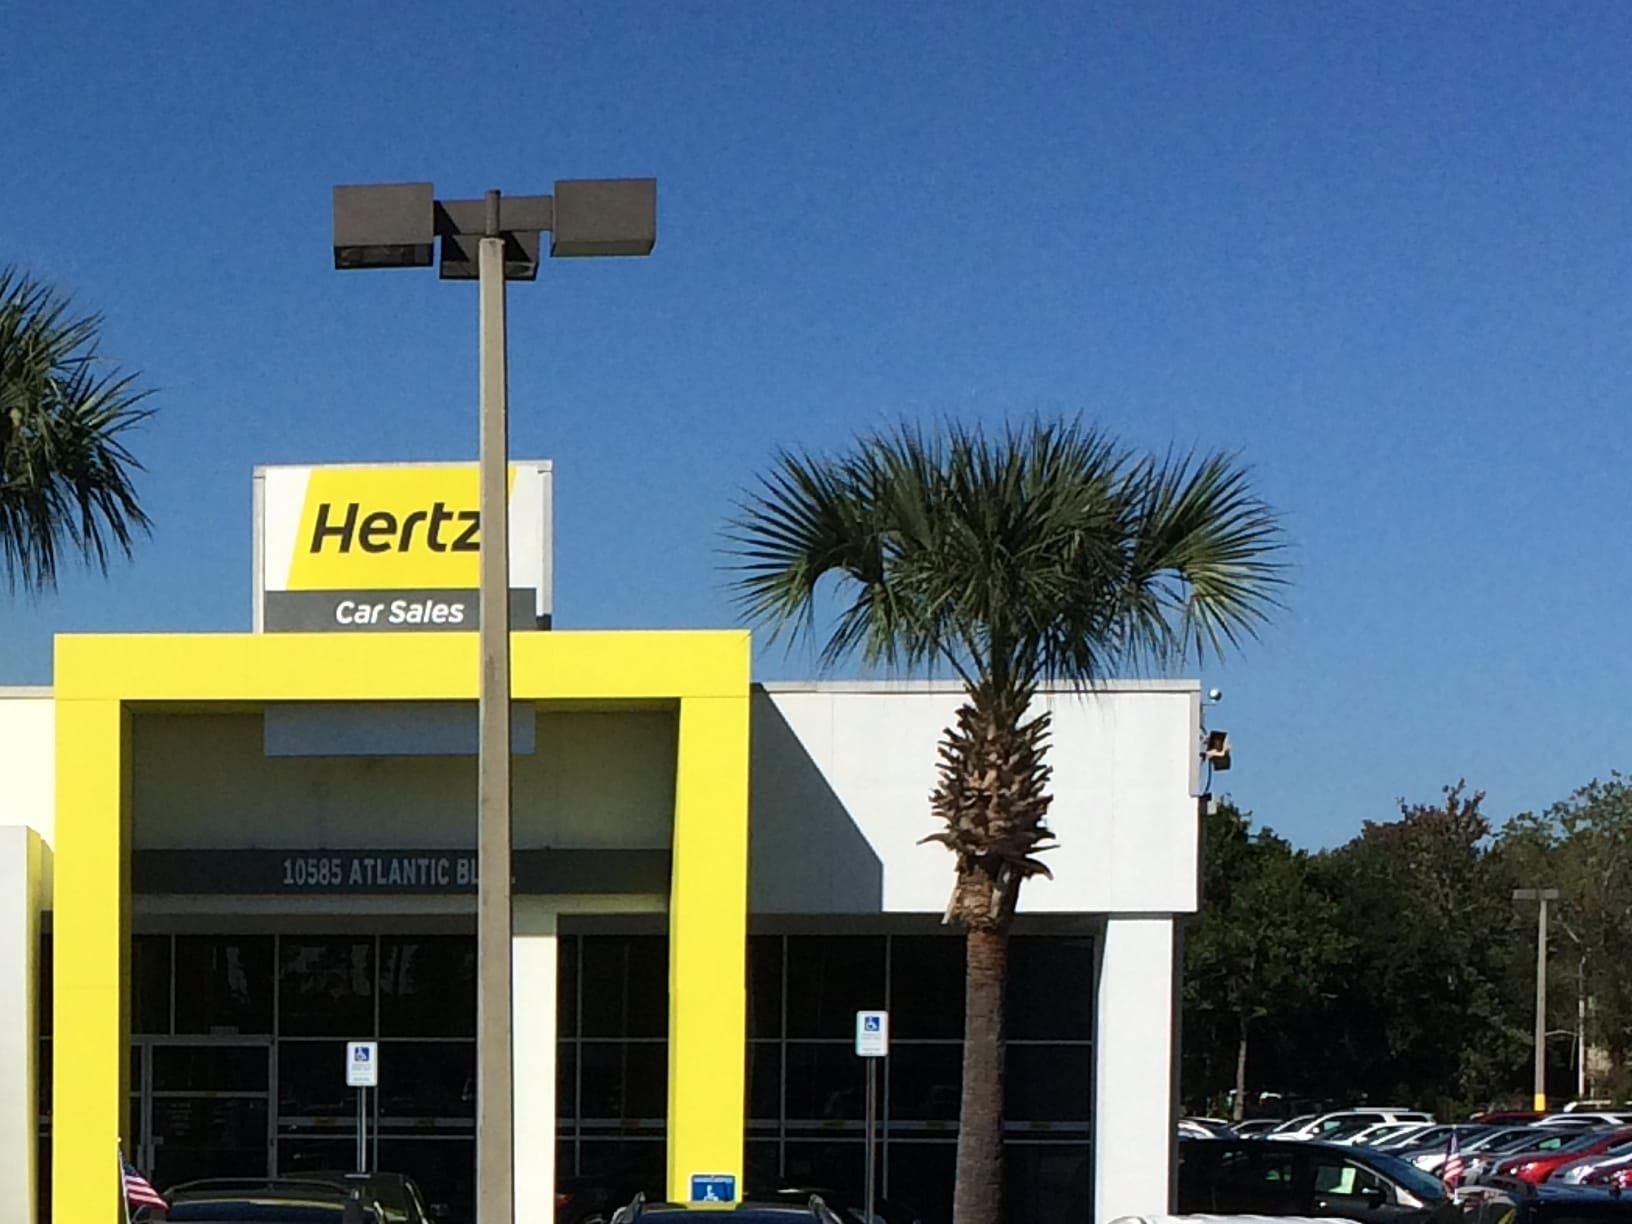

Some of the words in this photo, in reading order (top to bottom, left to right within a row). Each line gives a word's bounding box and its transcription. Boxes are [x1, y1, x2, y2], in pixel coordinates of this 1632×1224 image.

[309, 502, 481, 553] Hertz
[336, 601, 384, 624] Car
[388, 599, 464, 624] Sales
[283, 858, 342, 885] 10585
[348, 858, 450, 885] ATLANTIC
